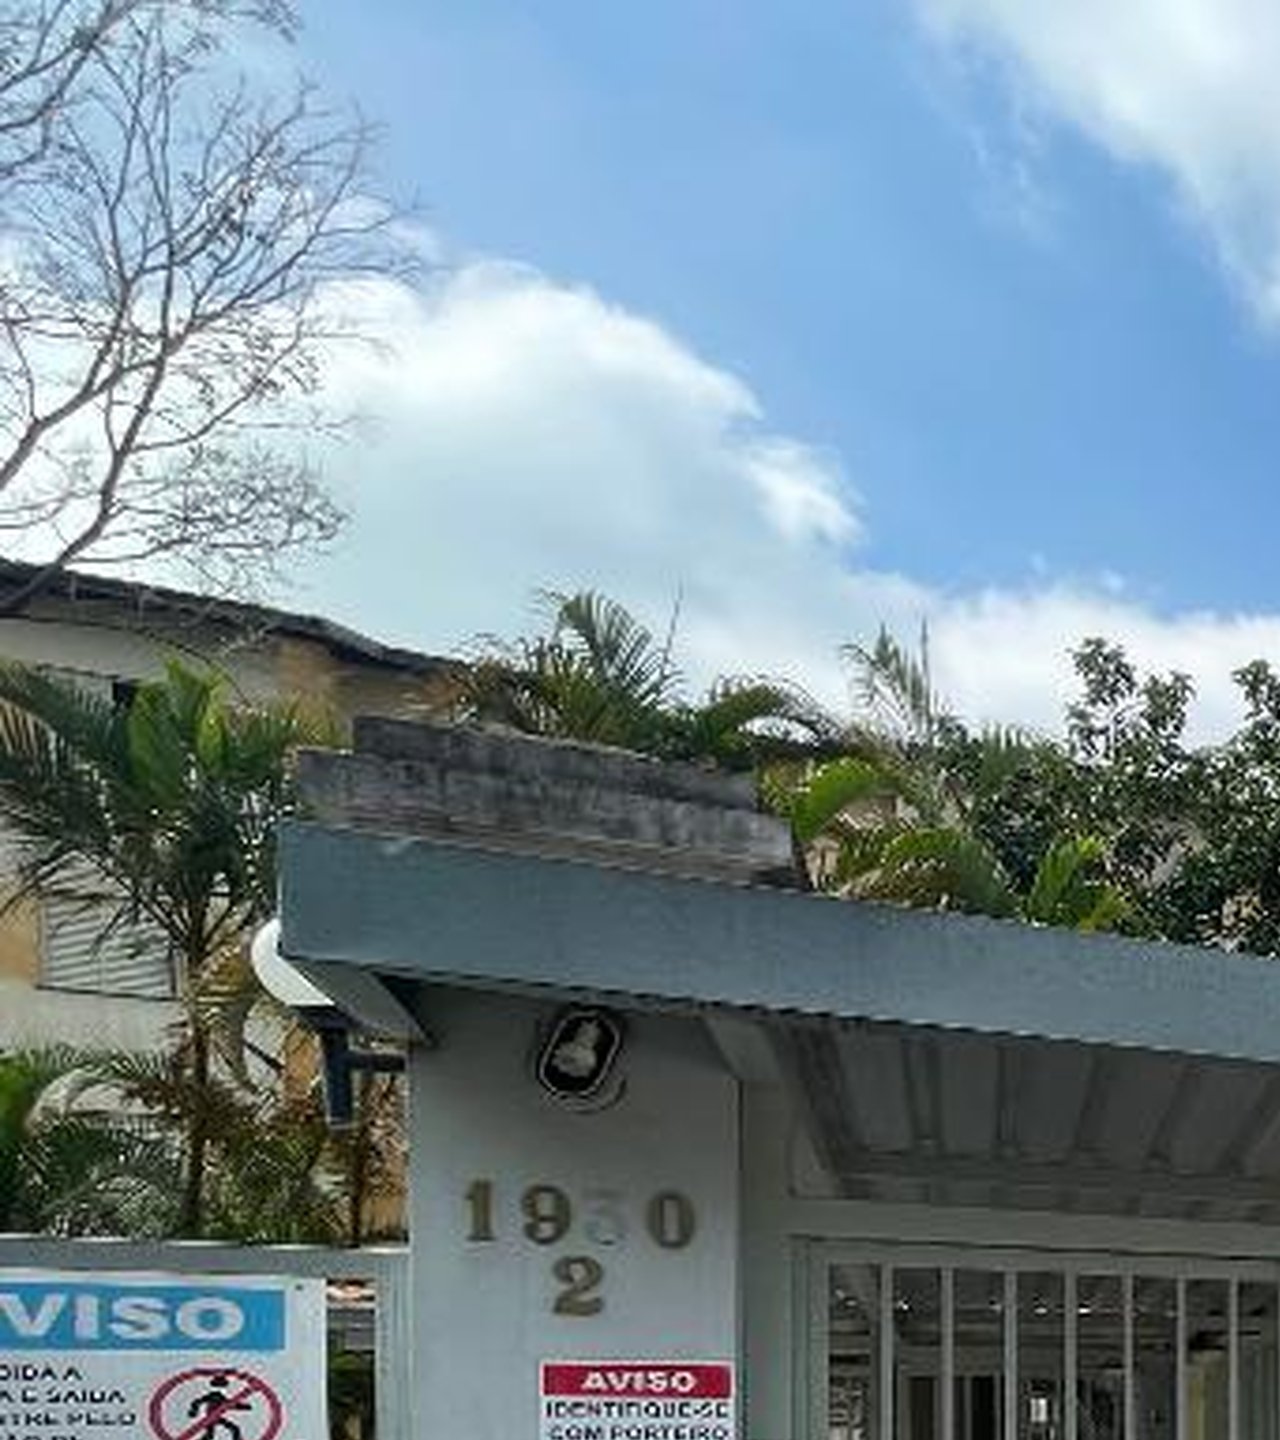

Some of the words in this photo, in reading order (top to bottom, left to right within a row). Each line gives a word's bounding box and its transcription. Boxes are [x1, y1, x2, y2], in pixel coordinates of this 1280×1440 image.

[553, 1254, 606, 1317] 2
[581, 1370, 698, 1393] AVISO
[550, 1425, 604, 1440] COM
